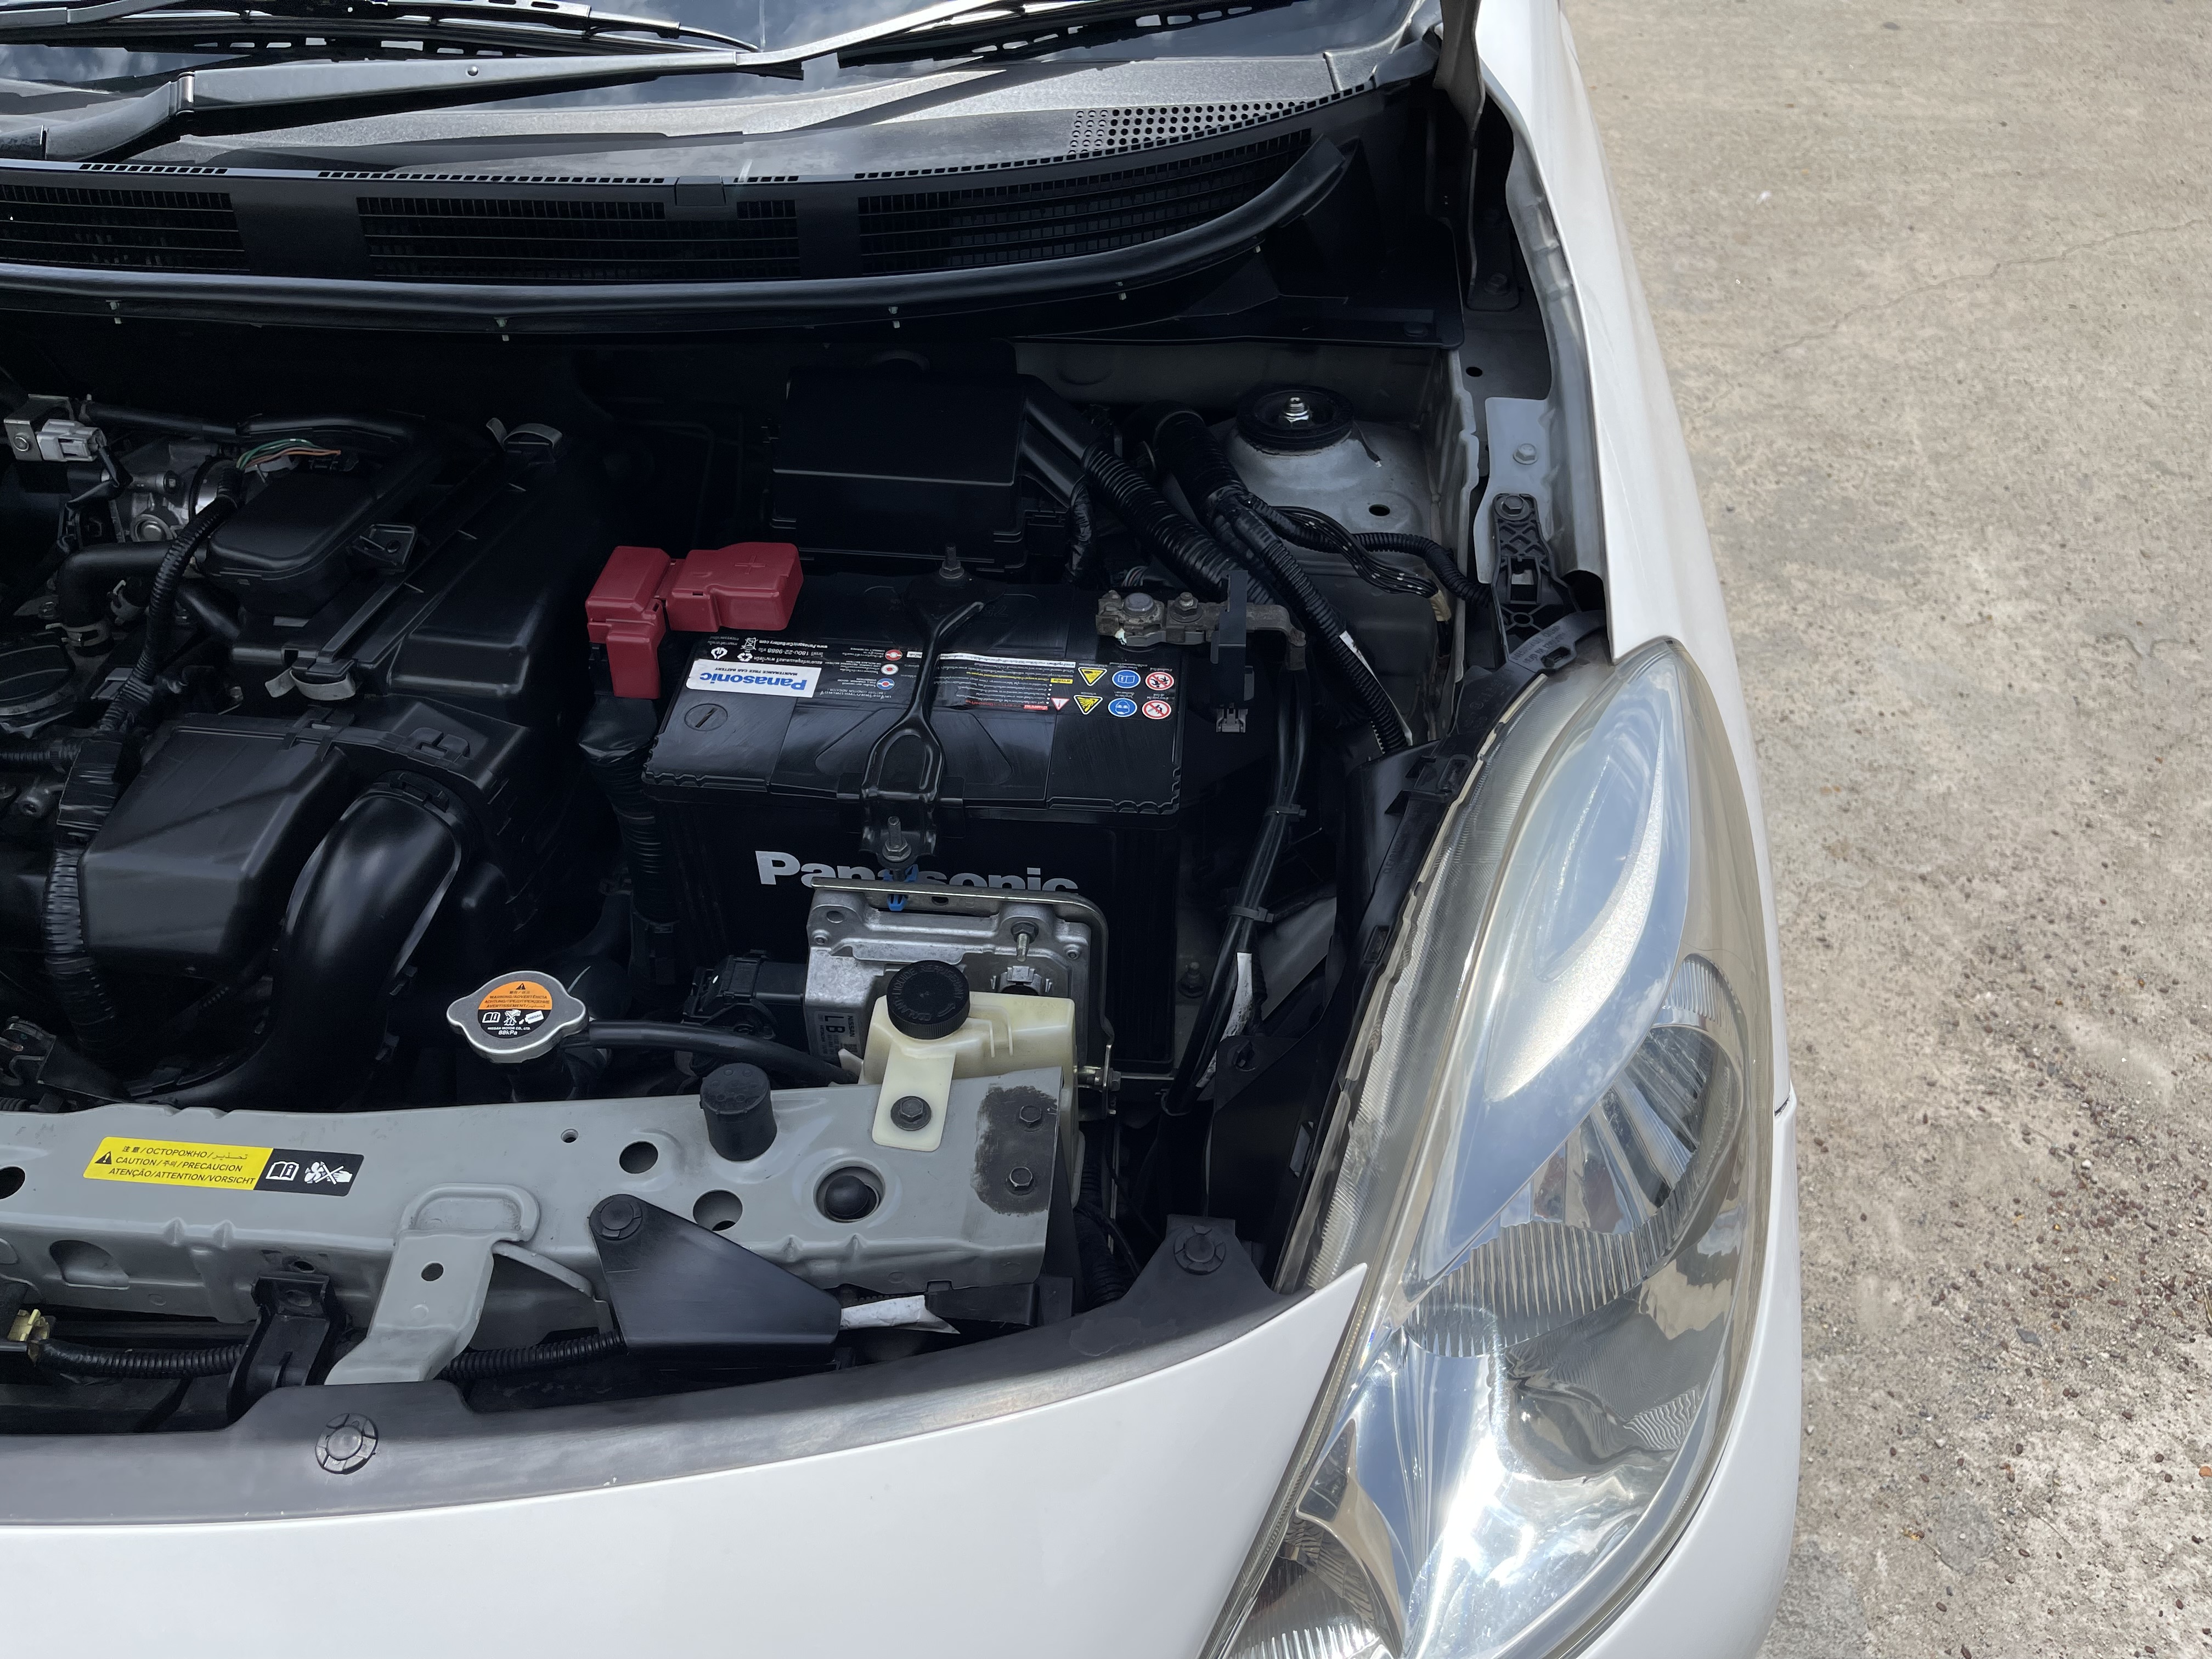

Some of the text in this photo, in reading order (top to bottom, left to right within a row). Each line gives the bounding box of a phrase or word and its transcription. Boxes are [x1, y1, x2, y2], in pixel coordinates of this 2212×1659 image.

[699, 672, 807, 690] Panasonic
[755, 850, 1079, 894] Pansonic
[847, 1015, 855, 1037] NISSAN
[108, 1167, 256, 1184] ATENÇÃO/ATTENTION/VORSICHT
